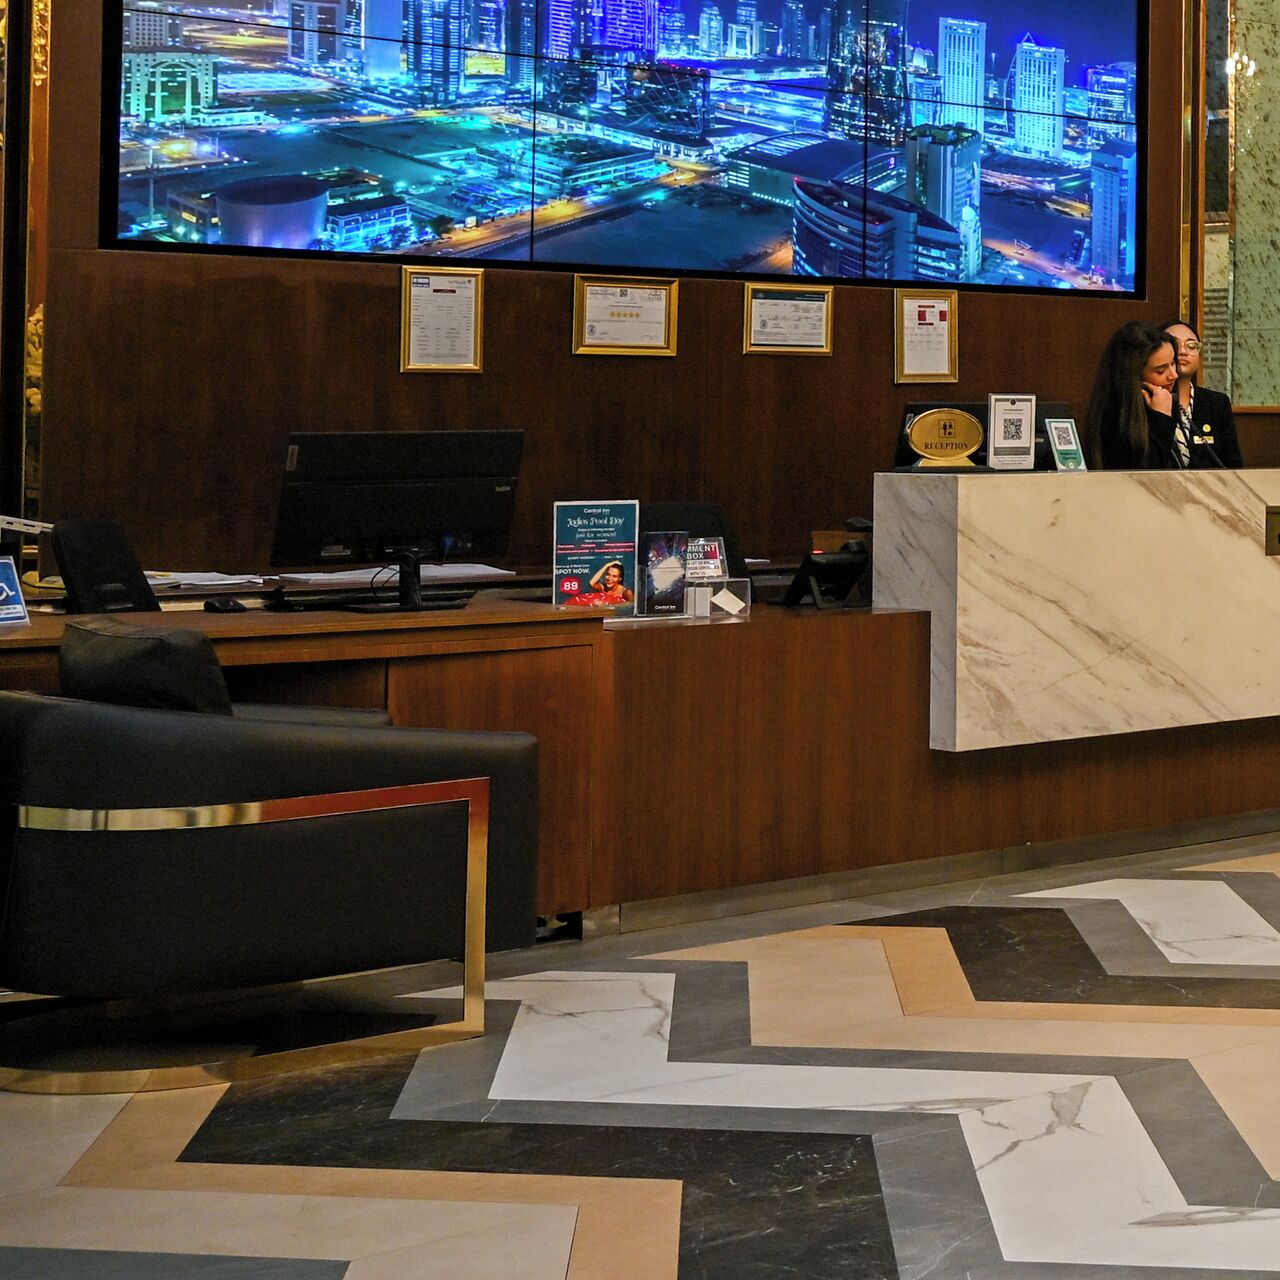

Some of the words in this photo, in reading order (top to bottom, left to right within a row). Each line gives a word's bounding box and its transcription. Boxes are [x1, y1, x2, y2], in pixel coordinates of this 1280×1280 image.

[924, 441, 968, 450] RECEPTION
[687, 544, 716, 553] MMENT
[563, 581, 578, 590] 89
